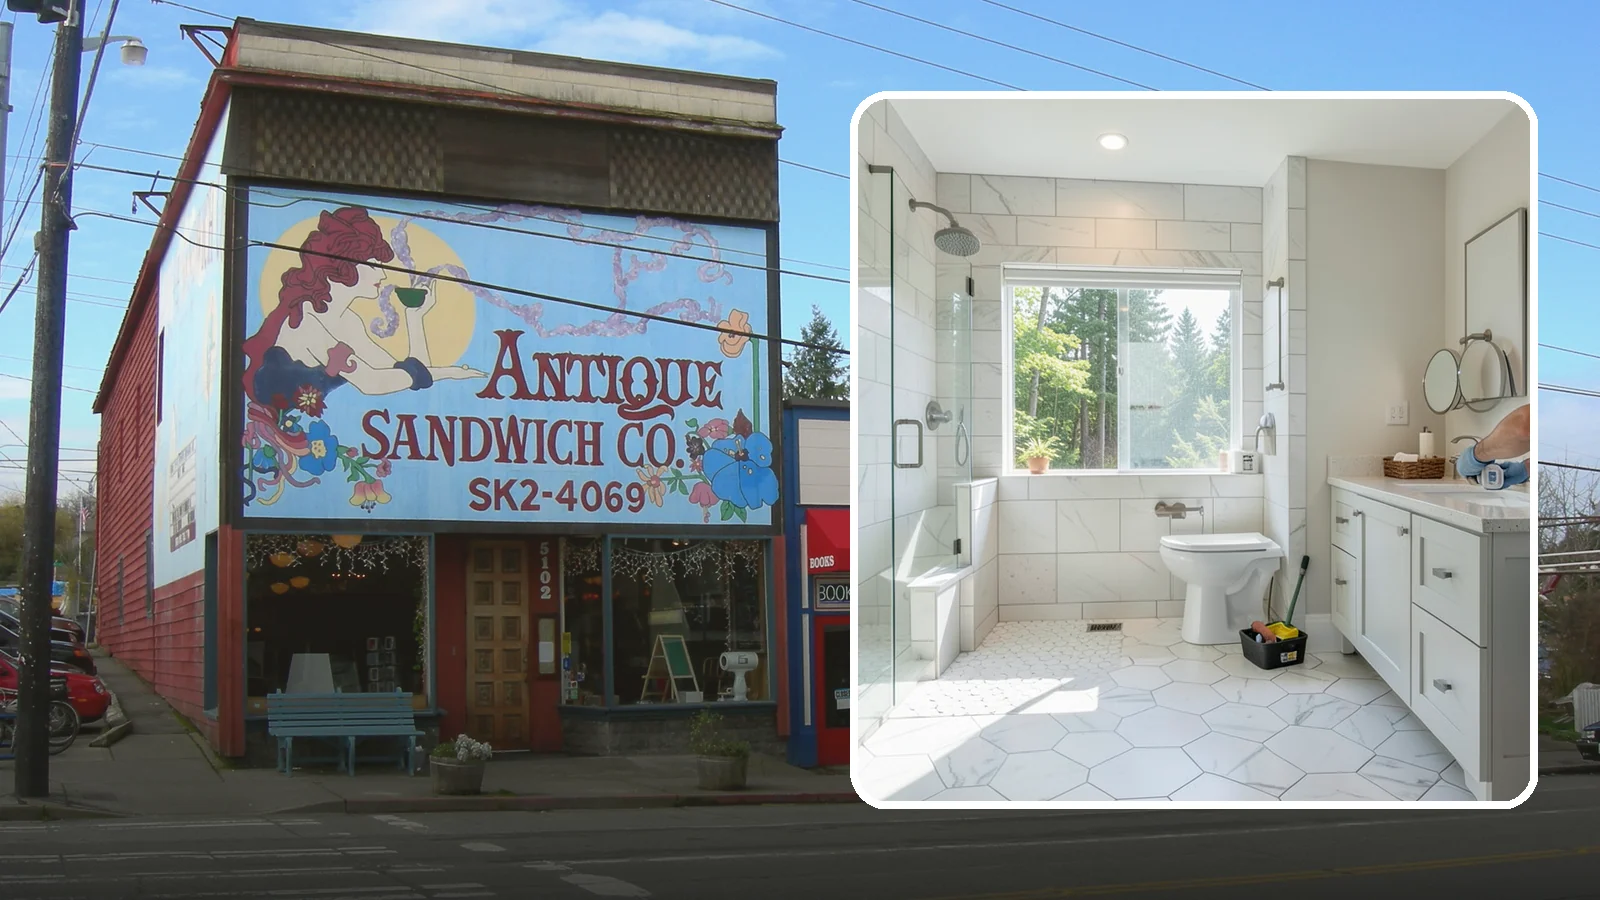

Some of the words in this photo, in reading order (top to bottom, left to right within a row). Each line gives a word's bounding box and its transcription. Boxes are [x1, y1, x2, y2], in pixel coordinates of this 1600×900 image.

[476, 329, 722, 421] ANTIQUE
[361, 408, 604, 467] SANDWICH
[616, 421, 685, 470] CO.
[468, 477, 646, 512] SK2-4069
[540, 542, 551, 600] 5102
[809, 555, 835, 569] BOOKS
